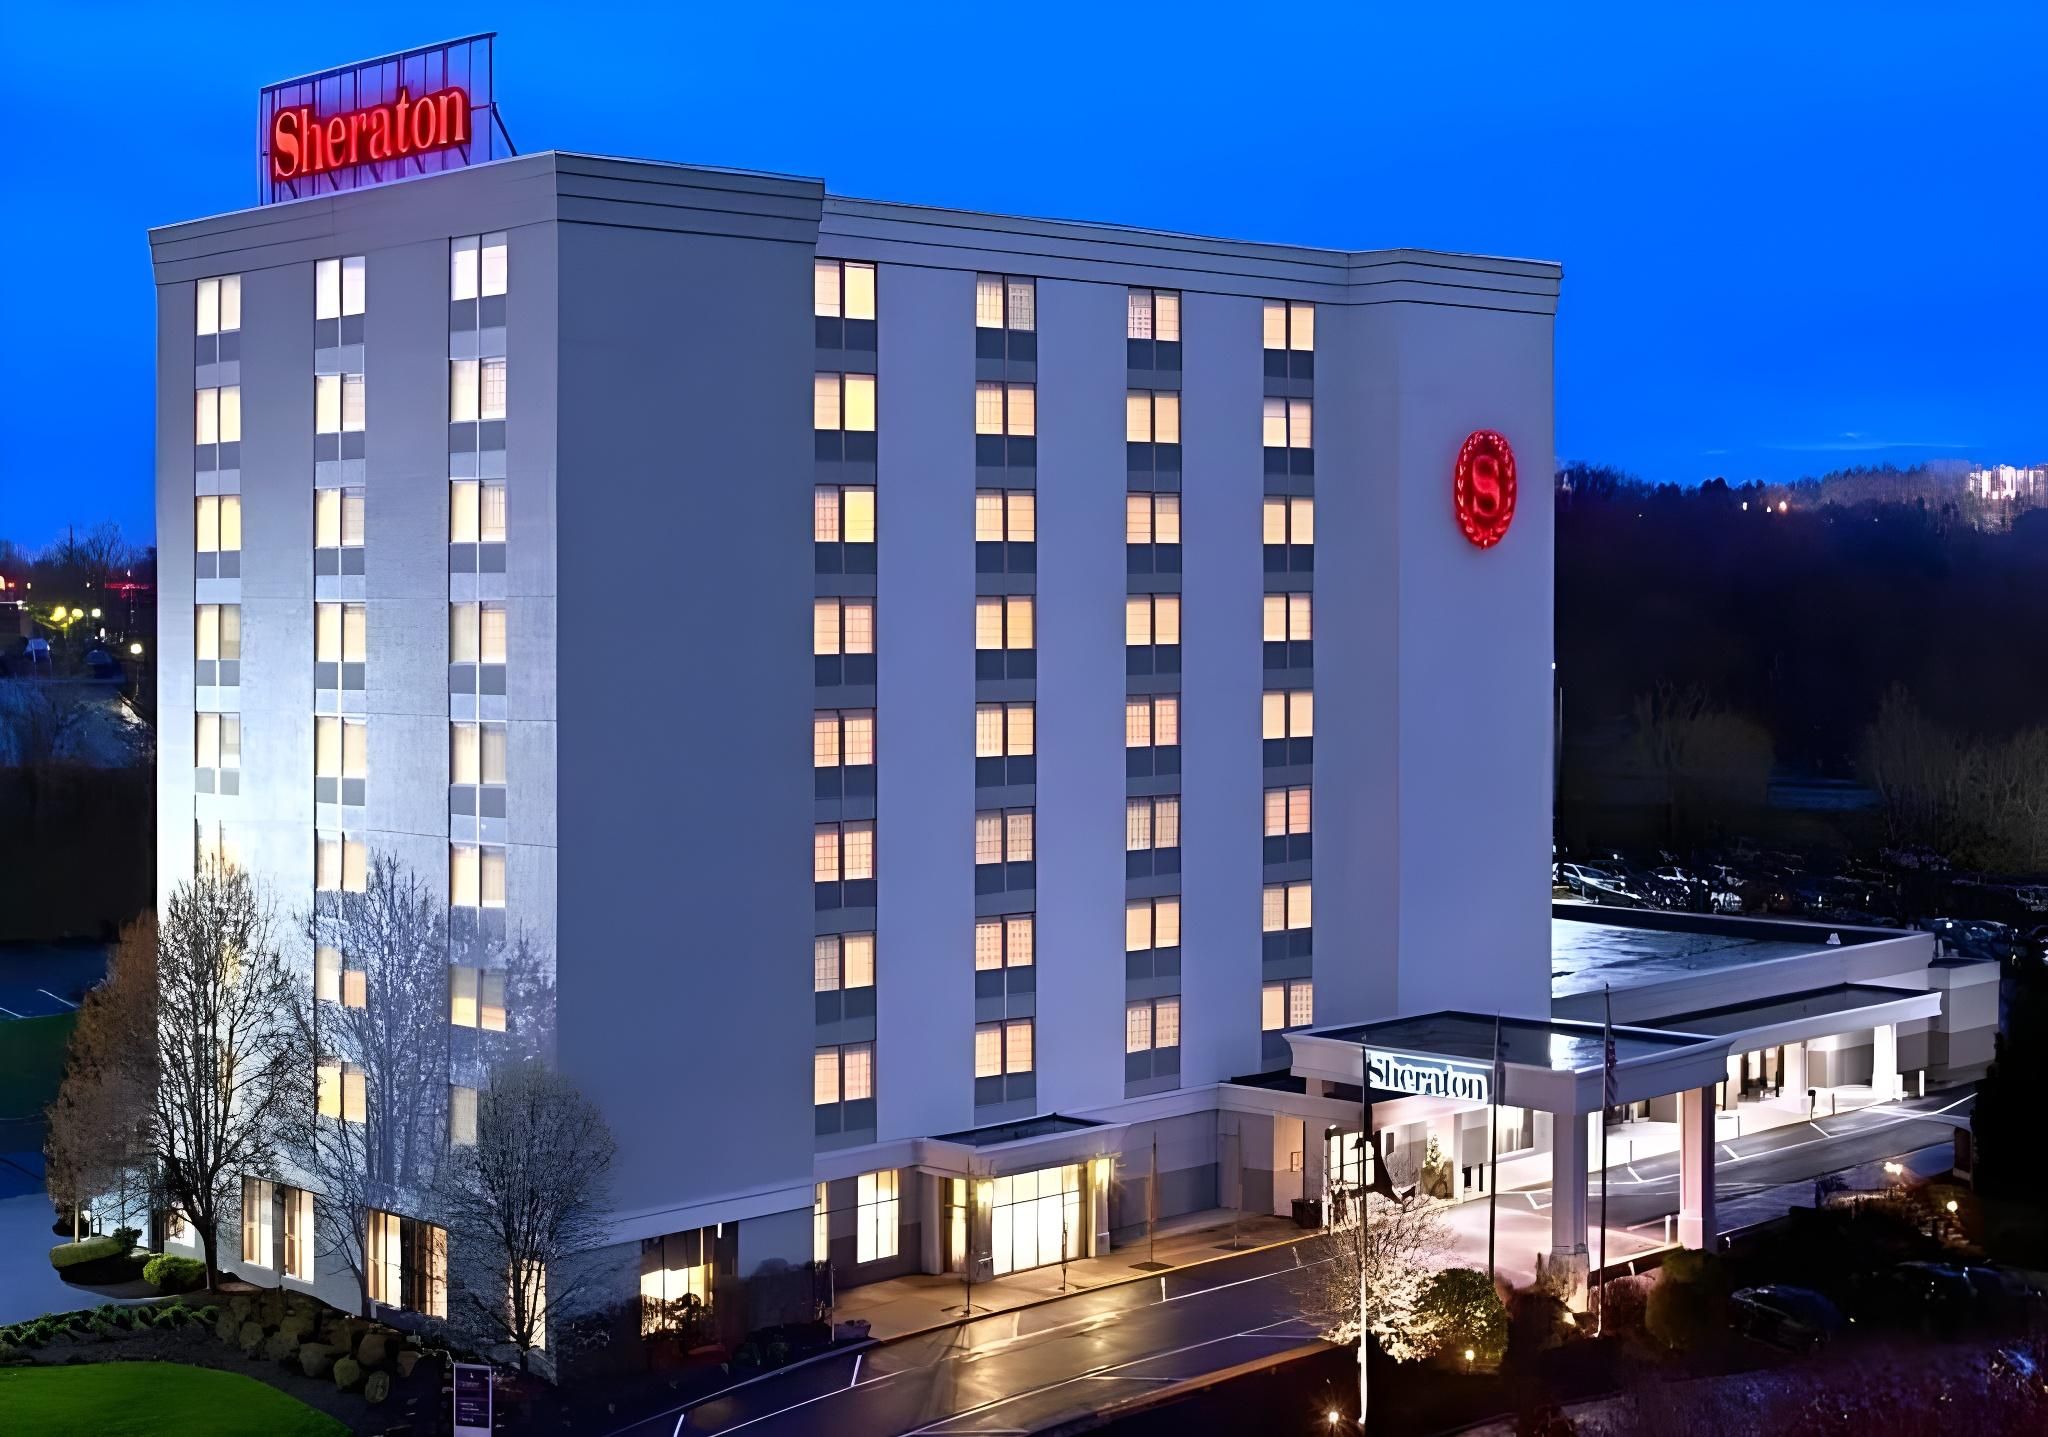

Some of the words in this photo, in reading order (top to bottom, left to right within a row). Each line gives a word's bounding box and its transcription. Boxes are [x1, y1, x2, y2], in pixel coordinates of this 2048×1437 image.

[273, 87, 467, 178] Sheraton
[1472, 455, 1500, 517] S
[1368, 1055, 1486, 1102] Sheraton
